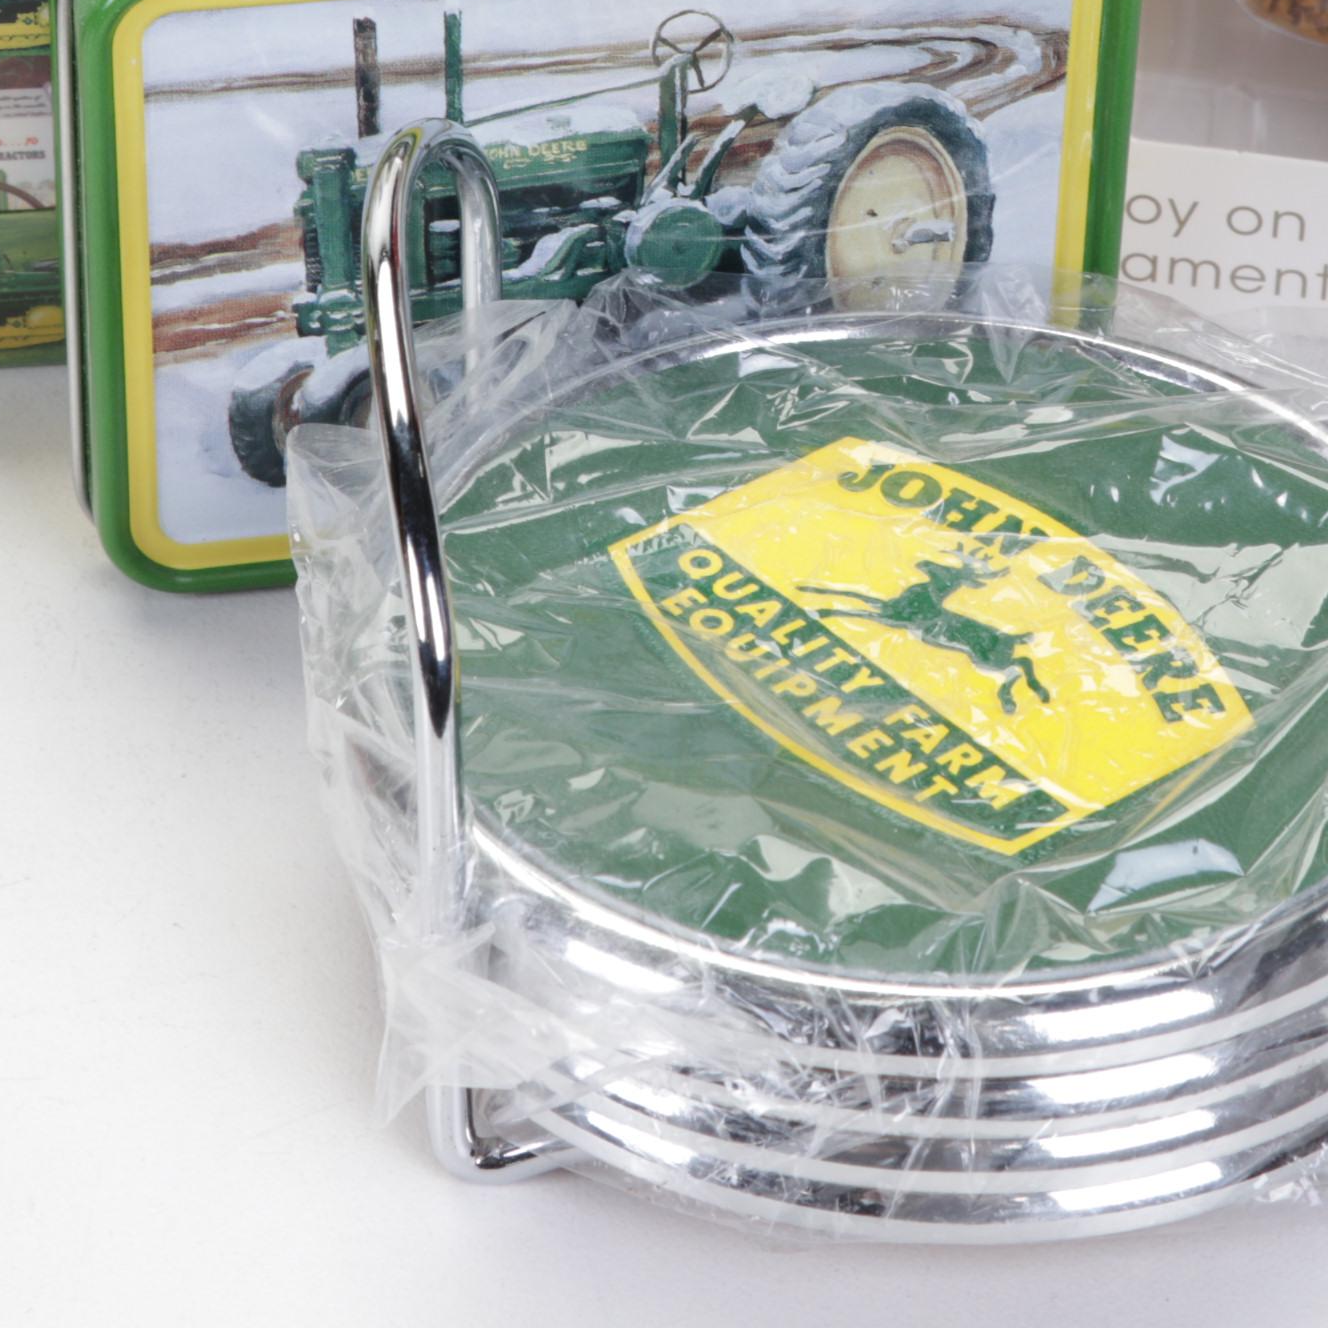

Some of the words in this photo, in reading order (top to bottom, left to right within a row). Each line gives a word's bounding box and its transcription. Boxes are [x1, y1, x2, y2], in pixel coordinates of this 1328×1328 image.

[1125, 194, 1200, 238] oy
[1226, 205, 1306, 242] on
[660, 588, 961, 805] EQUIPMENT
[677, 547, 885, 694] QUALITY
[882, 703, 1031, 812] FARM
[837, 464, 1050, 557] JOHN
[1037, 555, 1226, 724] DEERE
